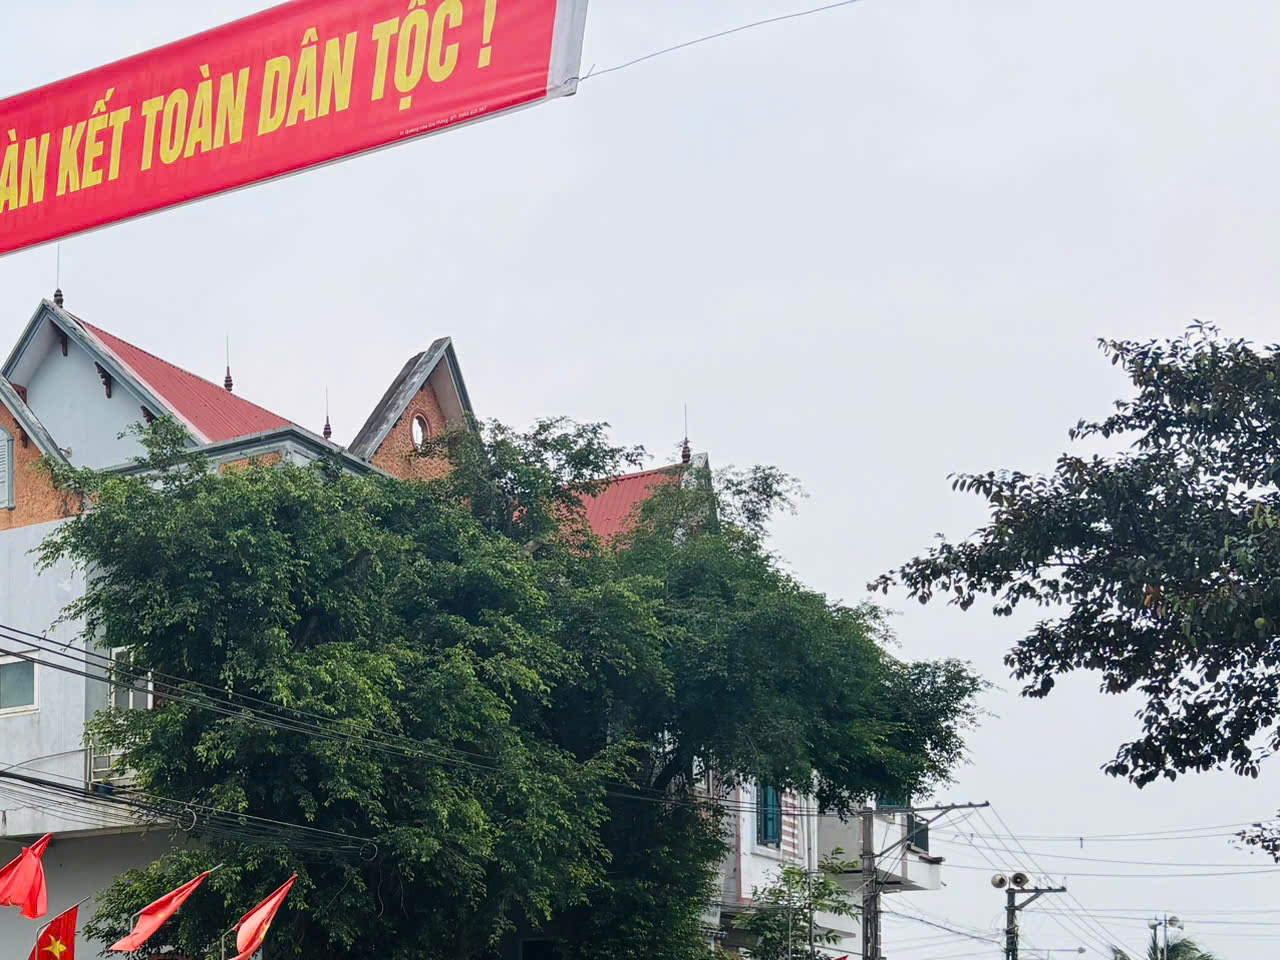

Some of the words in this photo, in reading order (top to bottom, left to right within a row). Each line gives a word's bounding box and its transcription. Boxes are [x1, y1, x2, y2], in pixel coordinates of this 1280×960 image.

[56, 88, 131, 197] KẾT
[141, 63, 250, 171] TOÀN
[257, 27, 358, 136] DÂN
[371, 0, 463, 111] TỘC
